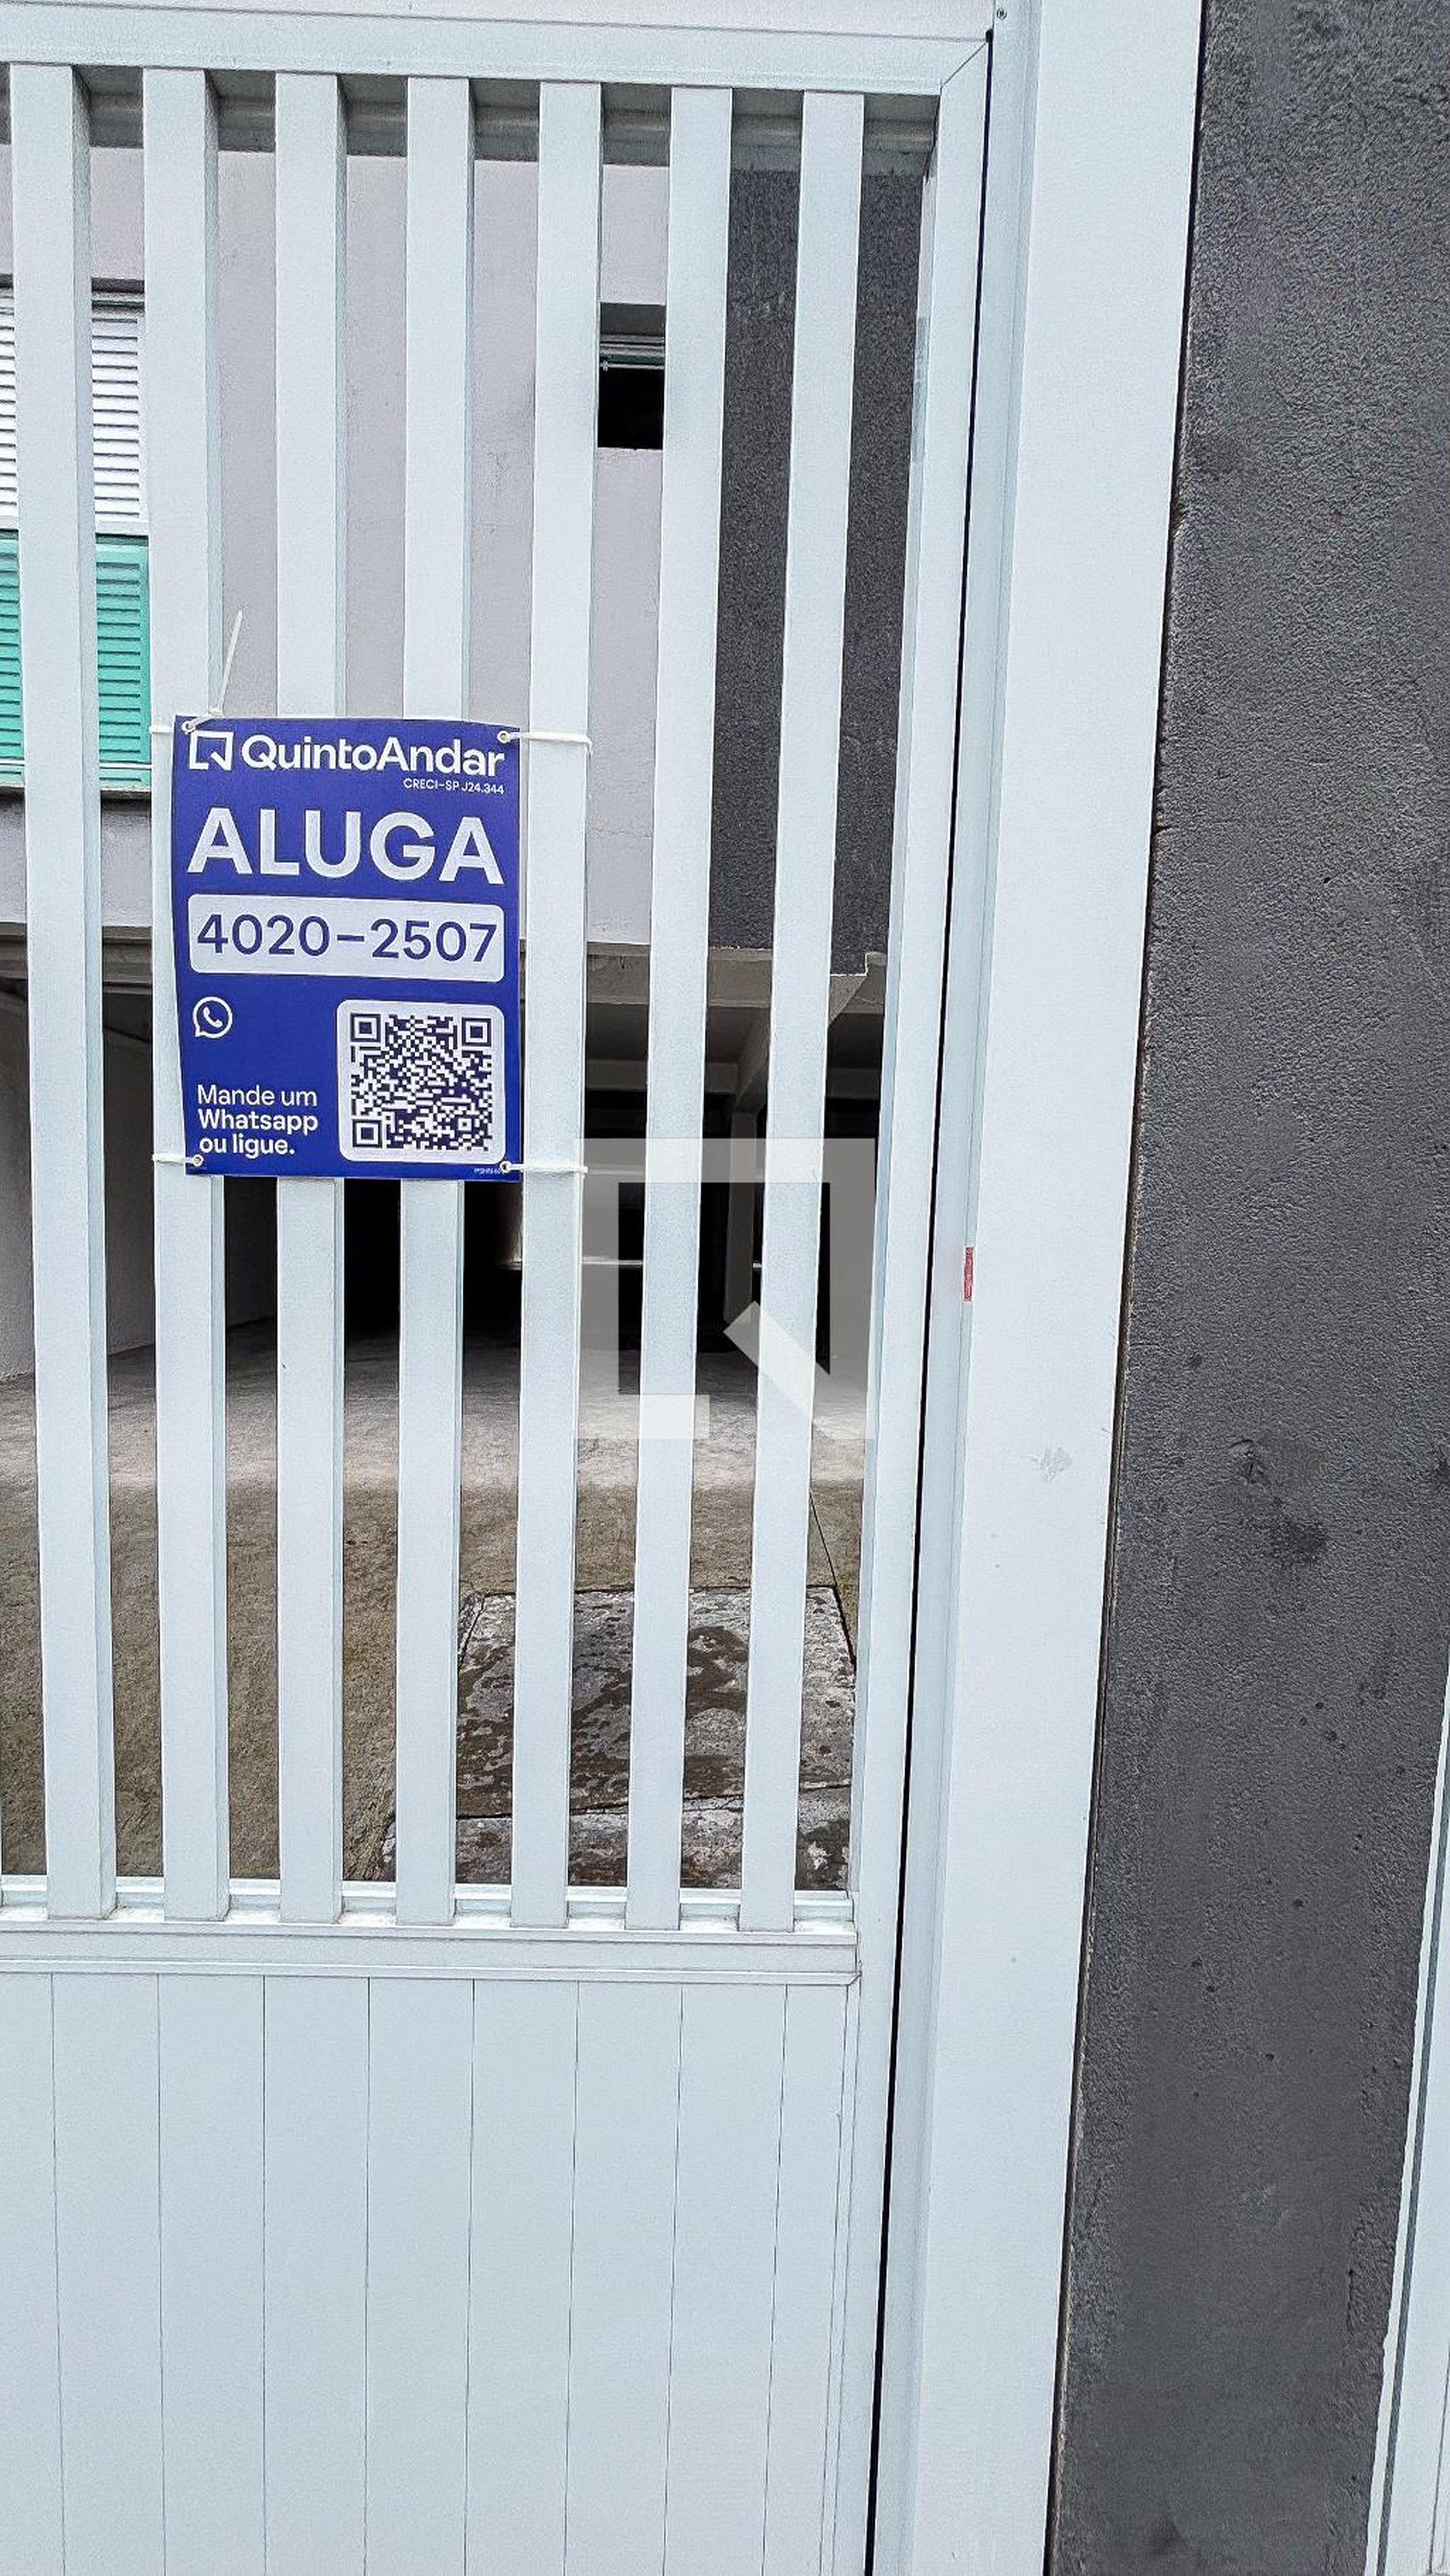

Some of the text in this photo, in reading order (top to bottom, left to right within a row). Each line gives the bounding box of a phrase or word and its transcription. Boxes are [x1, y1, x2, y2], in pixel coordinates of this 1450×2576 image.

[242, 734, 504, 776] QuintoAndar
[404, 778, 504, 794] CRECI-SP J24.344
[187, 808, 504, 884] ALUGA
[197, 914, 497, 962] 4020-2507
[198, 1085, 316, 1106] Mande um
[198, 1109, 318, 1133] Whatsapp
[200, 1134, 295, 1158] ou ligue.
